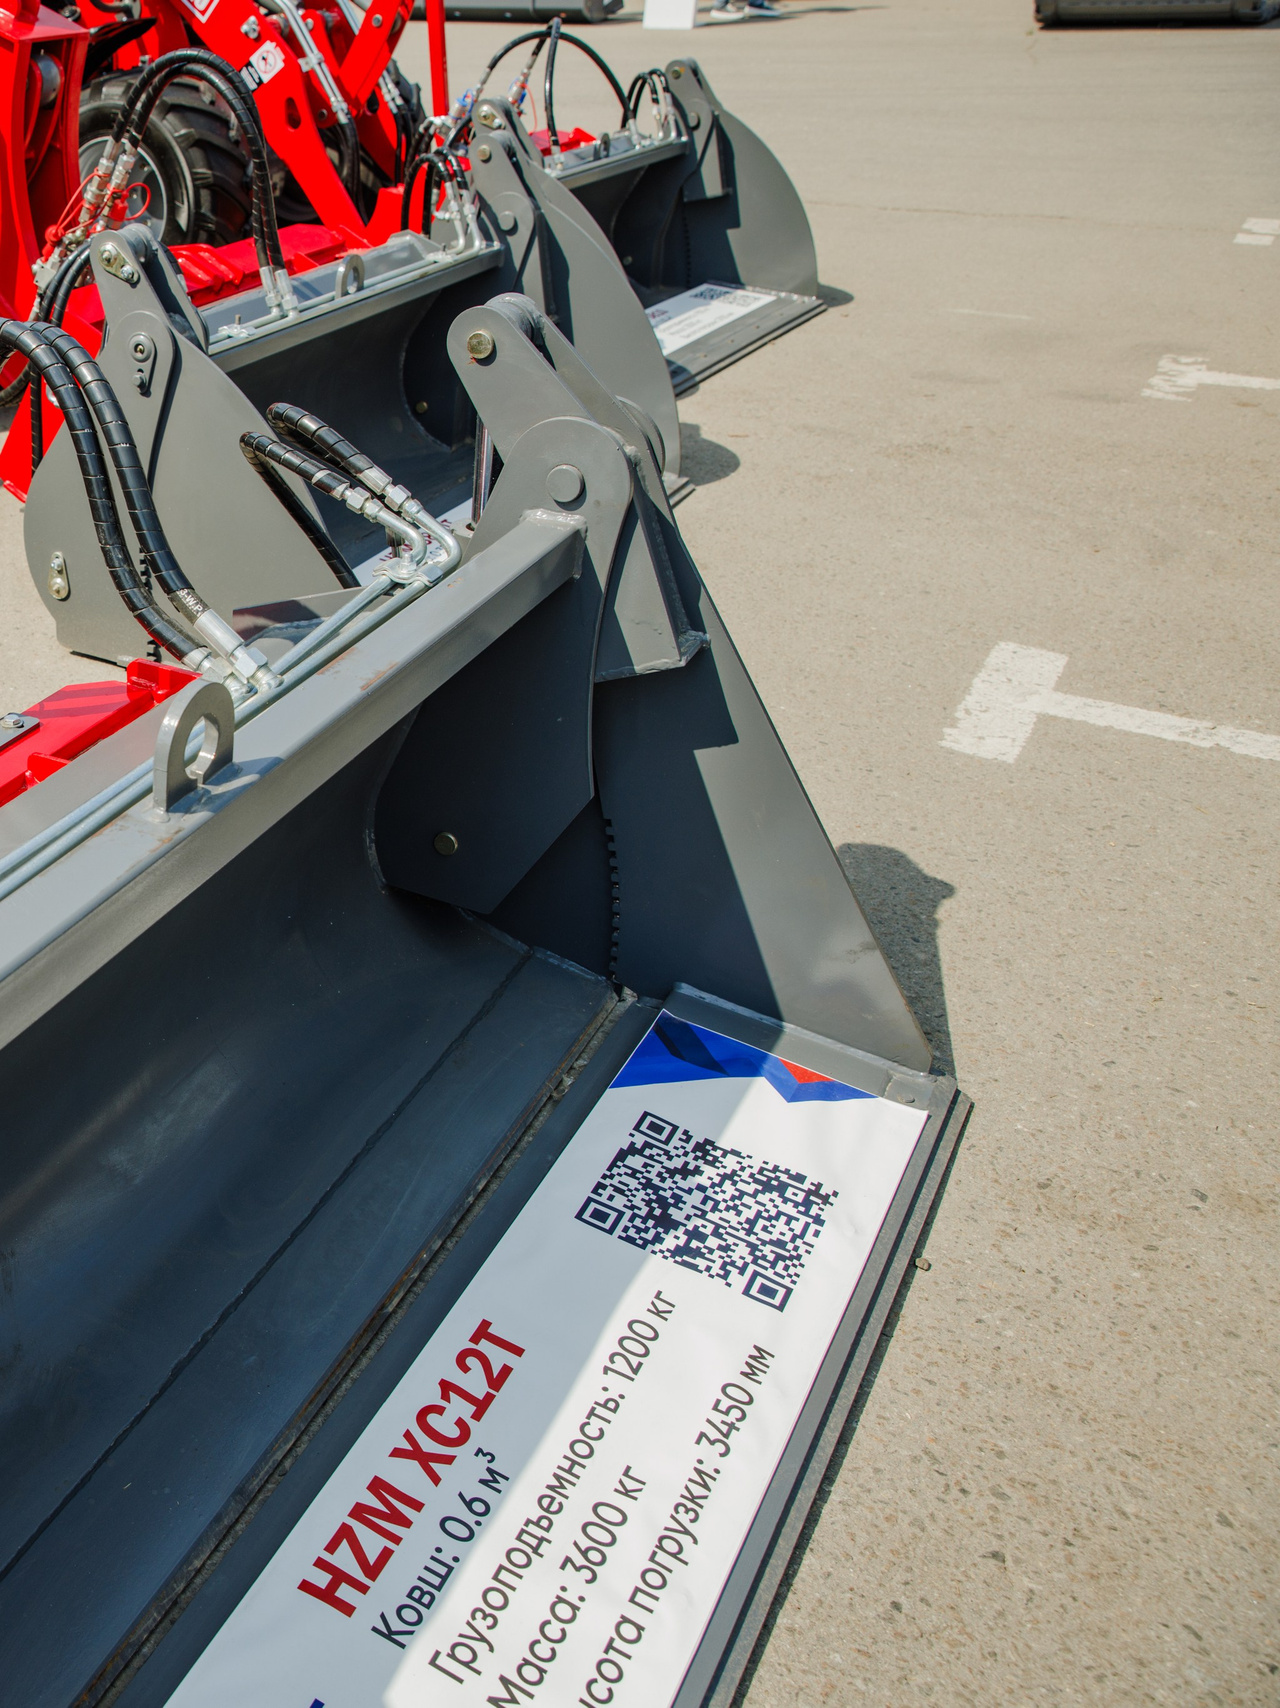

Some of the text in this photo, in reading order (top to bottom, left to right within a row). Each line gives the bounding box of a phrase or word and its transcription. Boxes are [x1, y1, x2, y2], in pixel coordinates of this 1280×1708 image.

[297, 1318, 526, 1618] HZM XC12T
[370, 1546, 460, 1650] Ковш:
[439, 1491, 491, 1542] 0.6
[428, 1289, 676, 1685] Грузоподъемность: 1200 кг
[486, 1465, 647, 1708] Масса: 3600 кг
[578, 1344, 775, 1708] сота погрузки: 3450 мм
